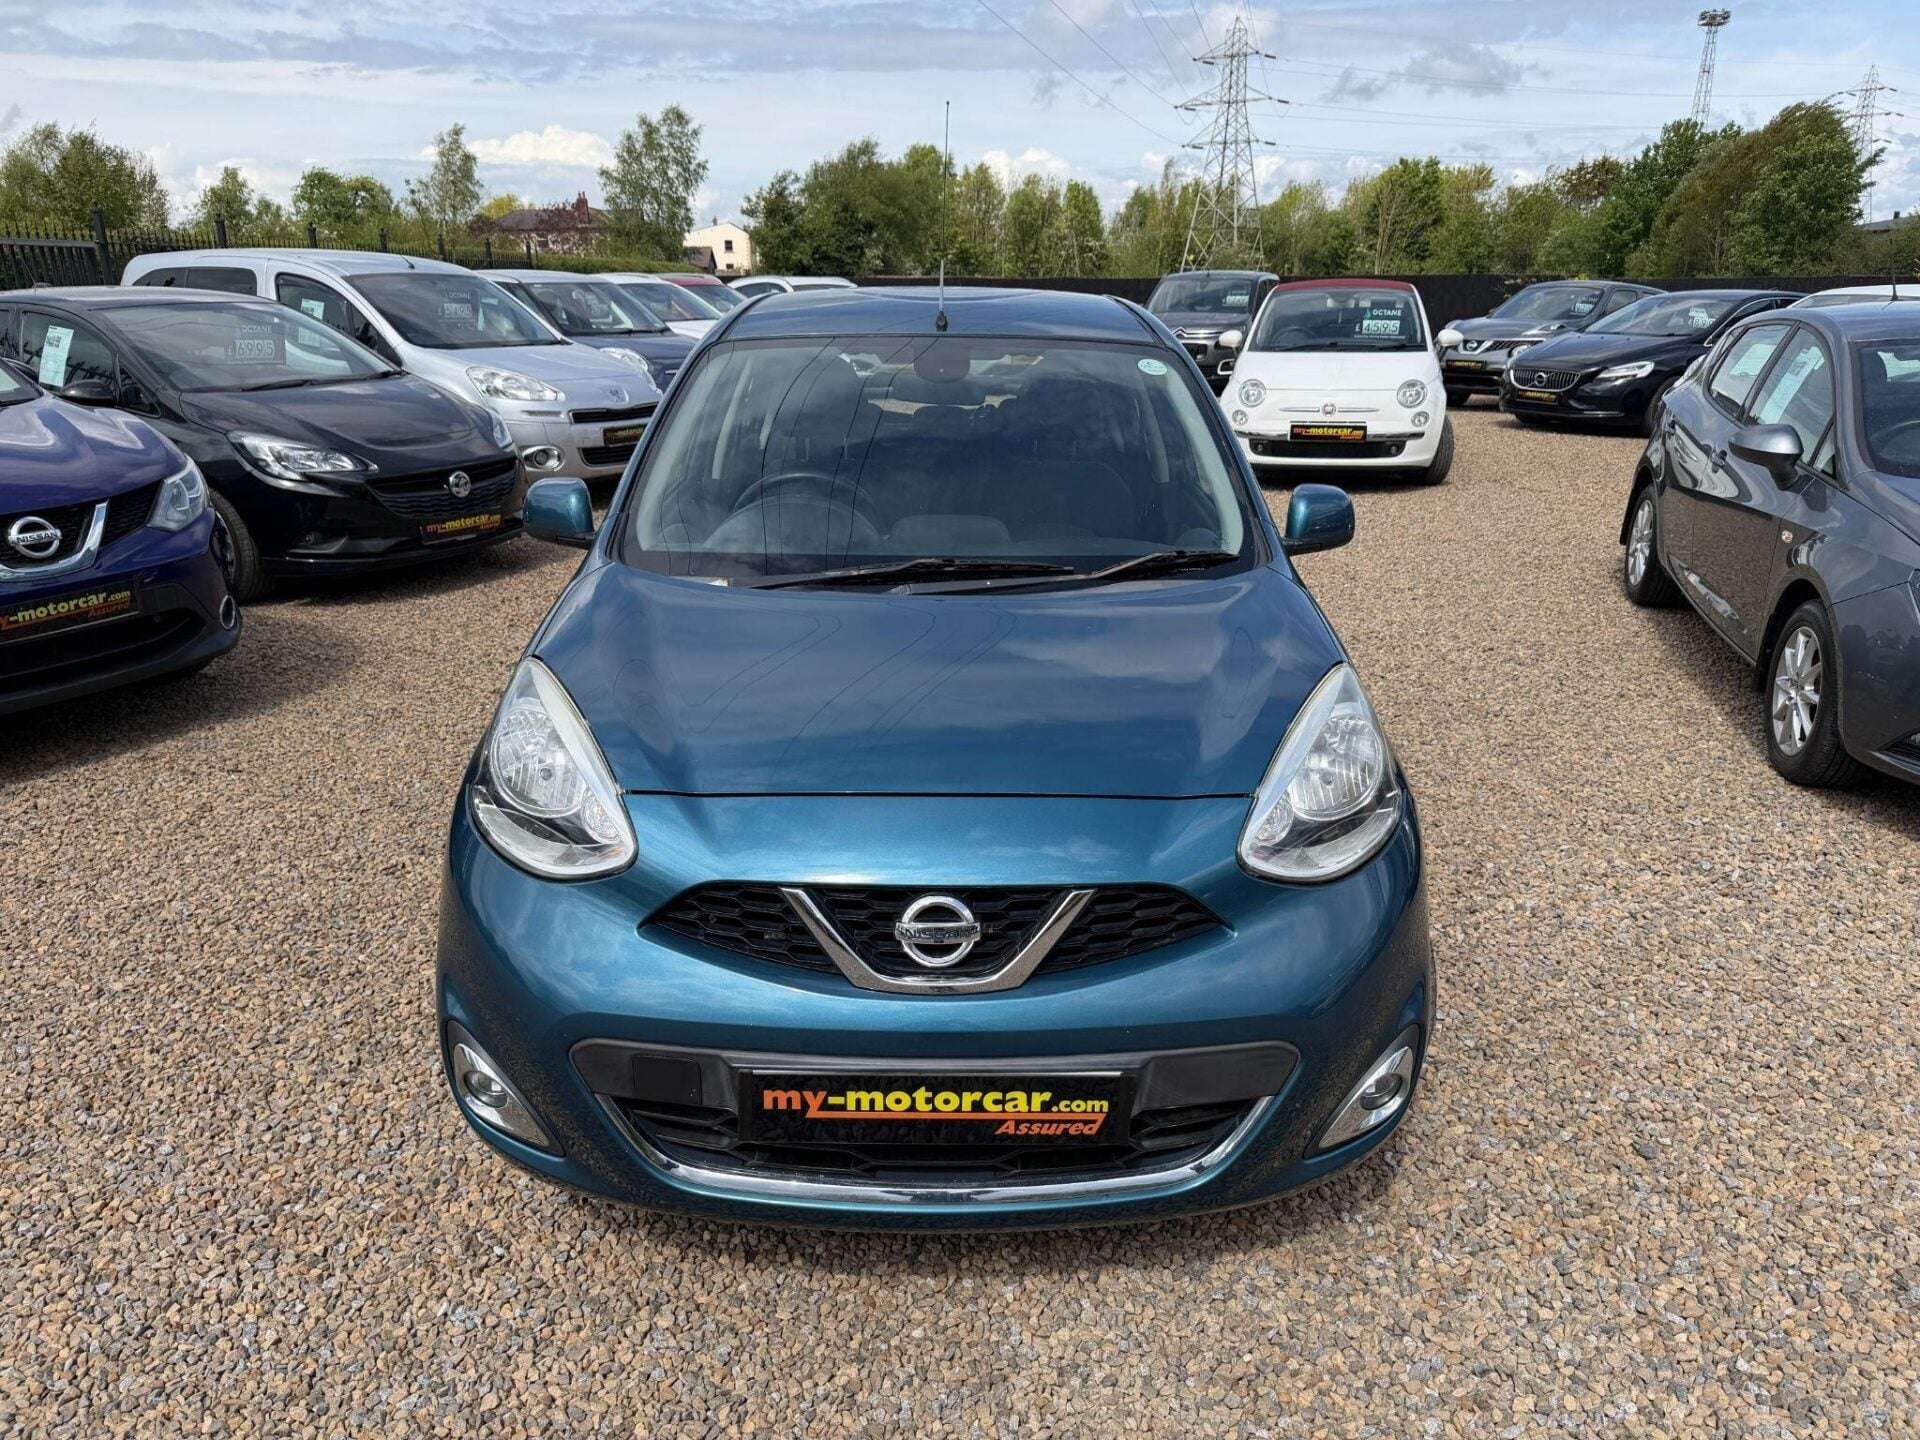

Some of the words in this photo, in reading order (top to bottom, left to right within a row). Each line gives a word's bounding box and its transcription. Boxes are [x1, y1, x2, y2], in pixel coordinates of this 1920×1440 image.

[16, 529, 58, 543] NISSAN
[763, 1087, 1109, 1118] my-motorcar.com
[994, 1119, 1104, 1136] Assured
